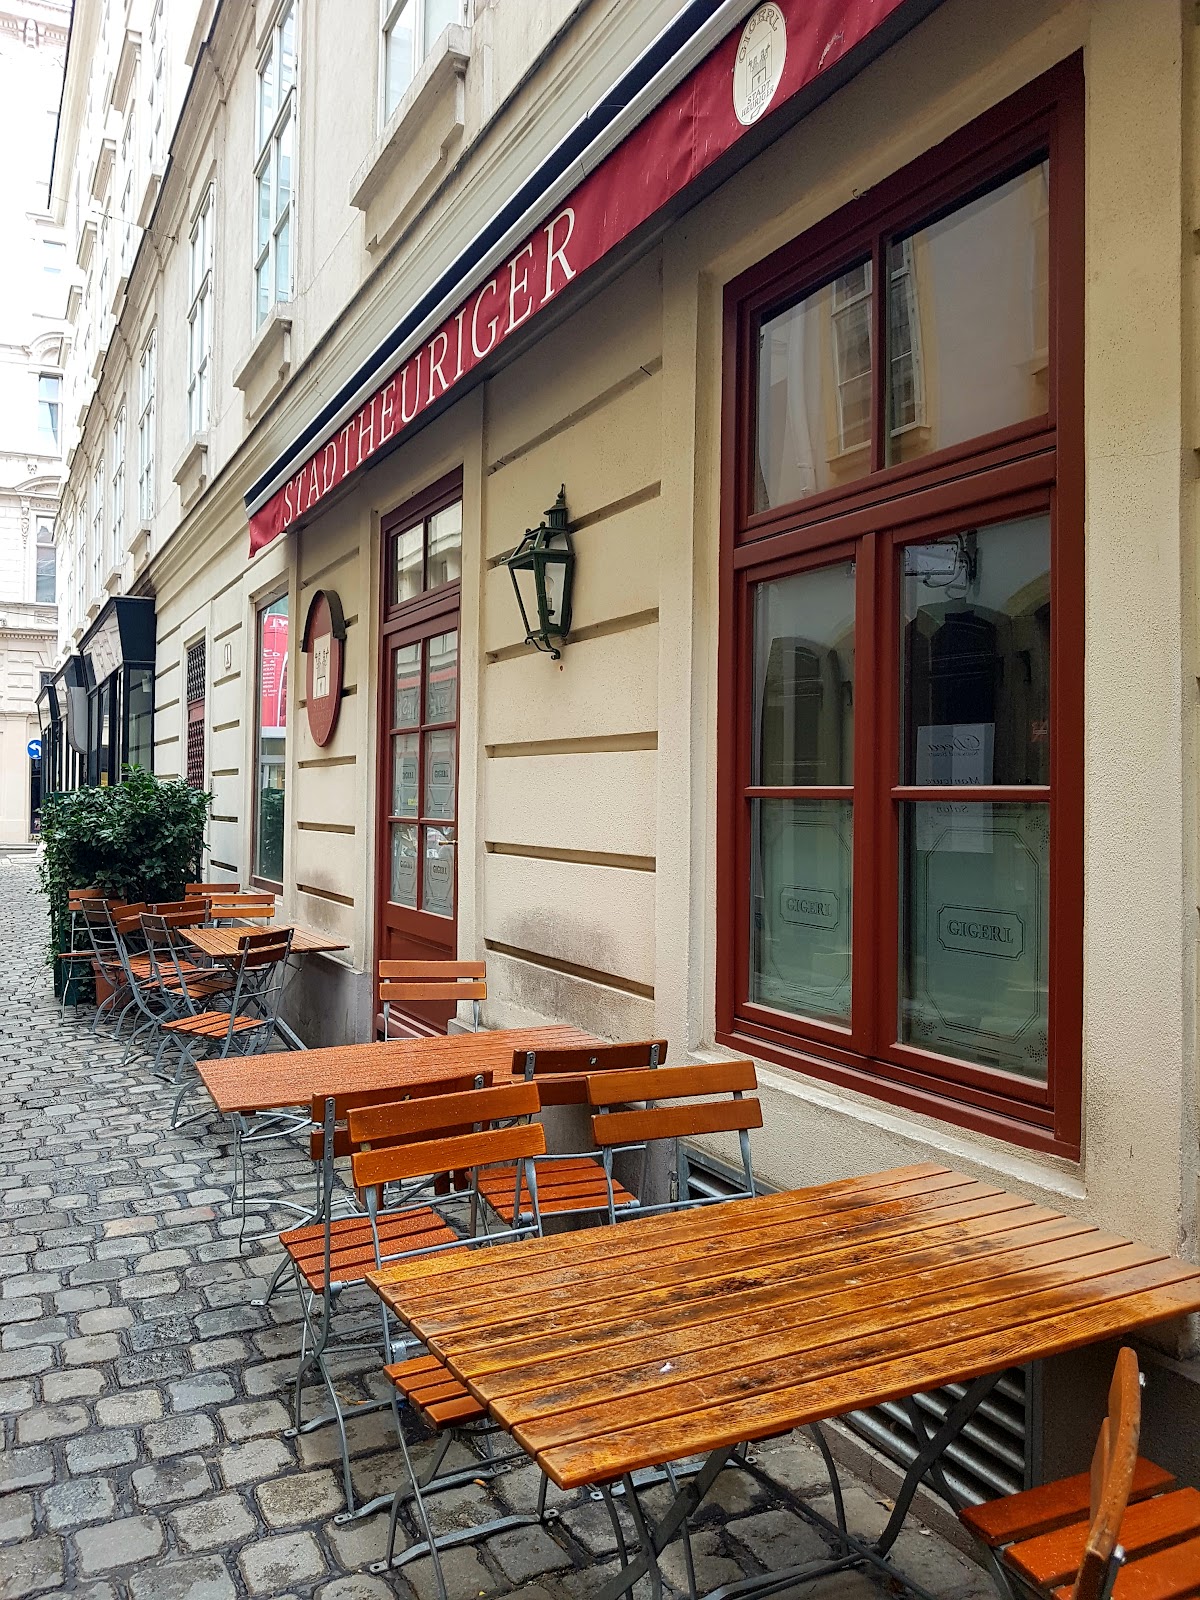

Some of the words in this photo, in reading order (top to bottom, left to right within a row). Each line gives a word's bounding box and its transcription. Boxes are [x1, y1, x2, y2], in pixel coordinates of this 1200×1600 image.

[738, 8, 780, 64] GIGERL
[747, 80, 771, 105] STADT
[283, 207, 577, 527] STADTHEURIGER
[786, 898, 832, 917] GIGERL
[946, 919, 1015, 944] GIGERL
